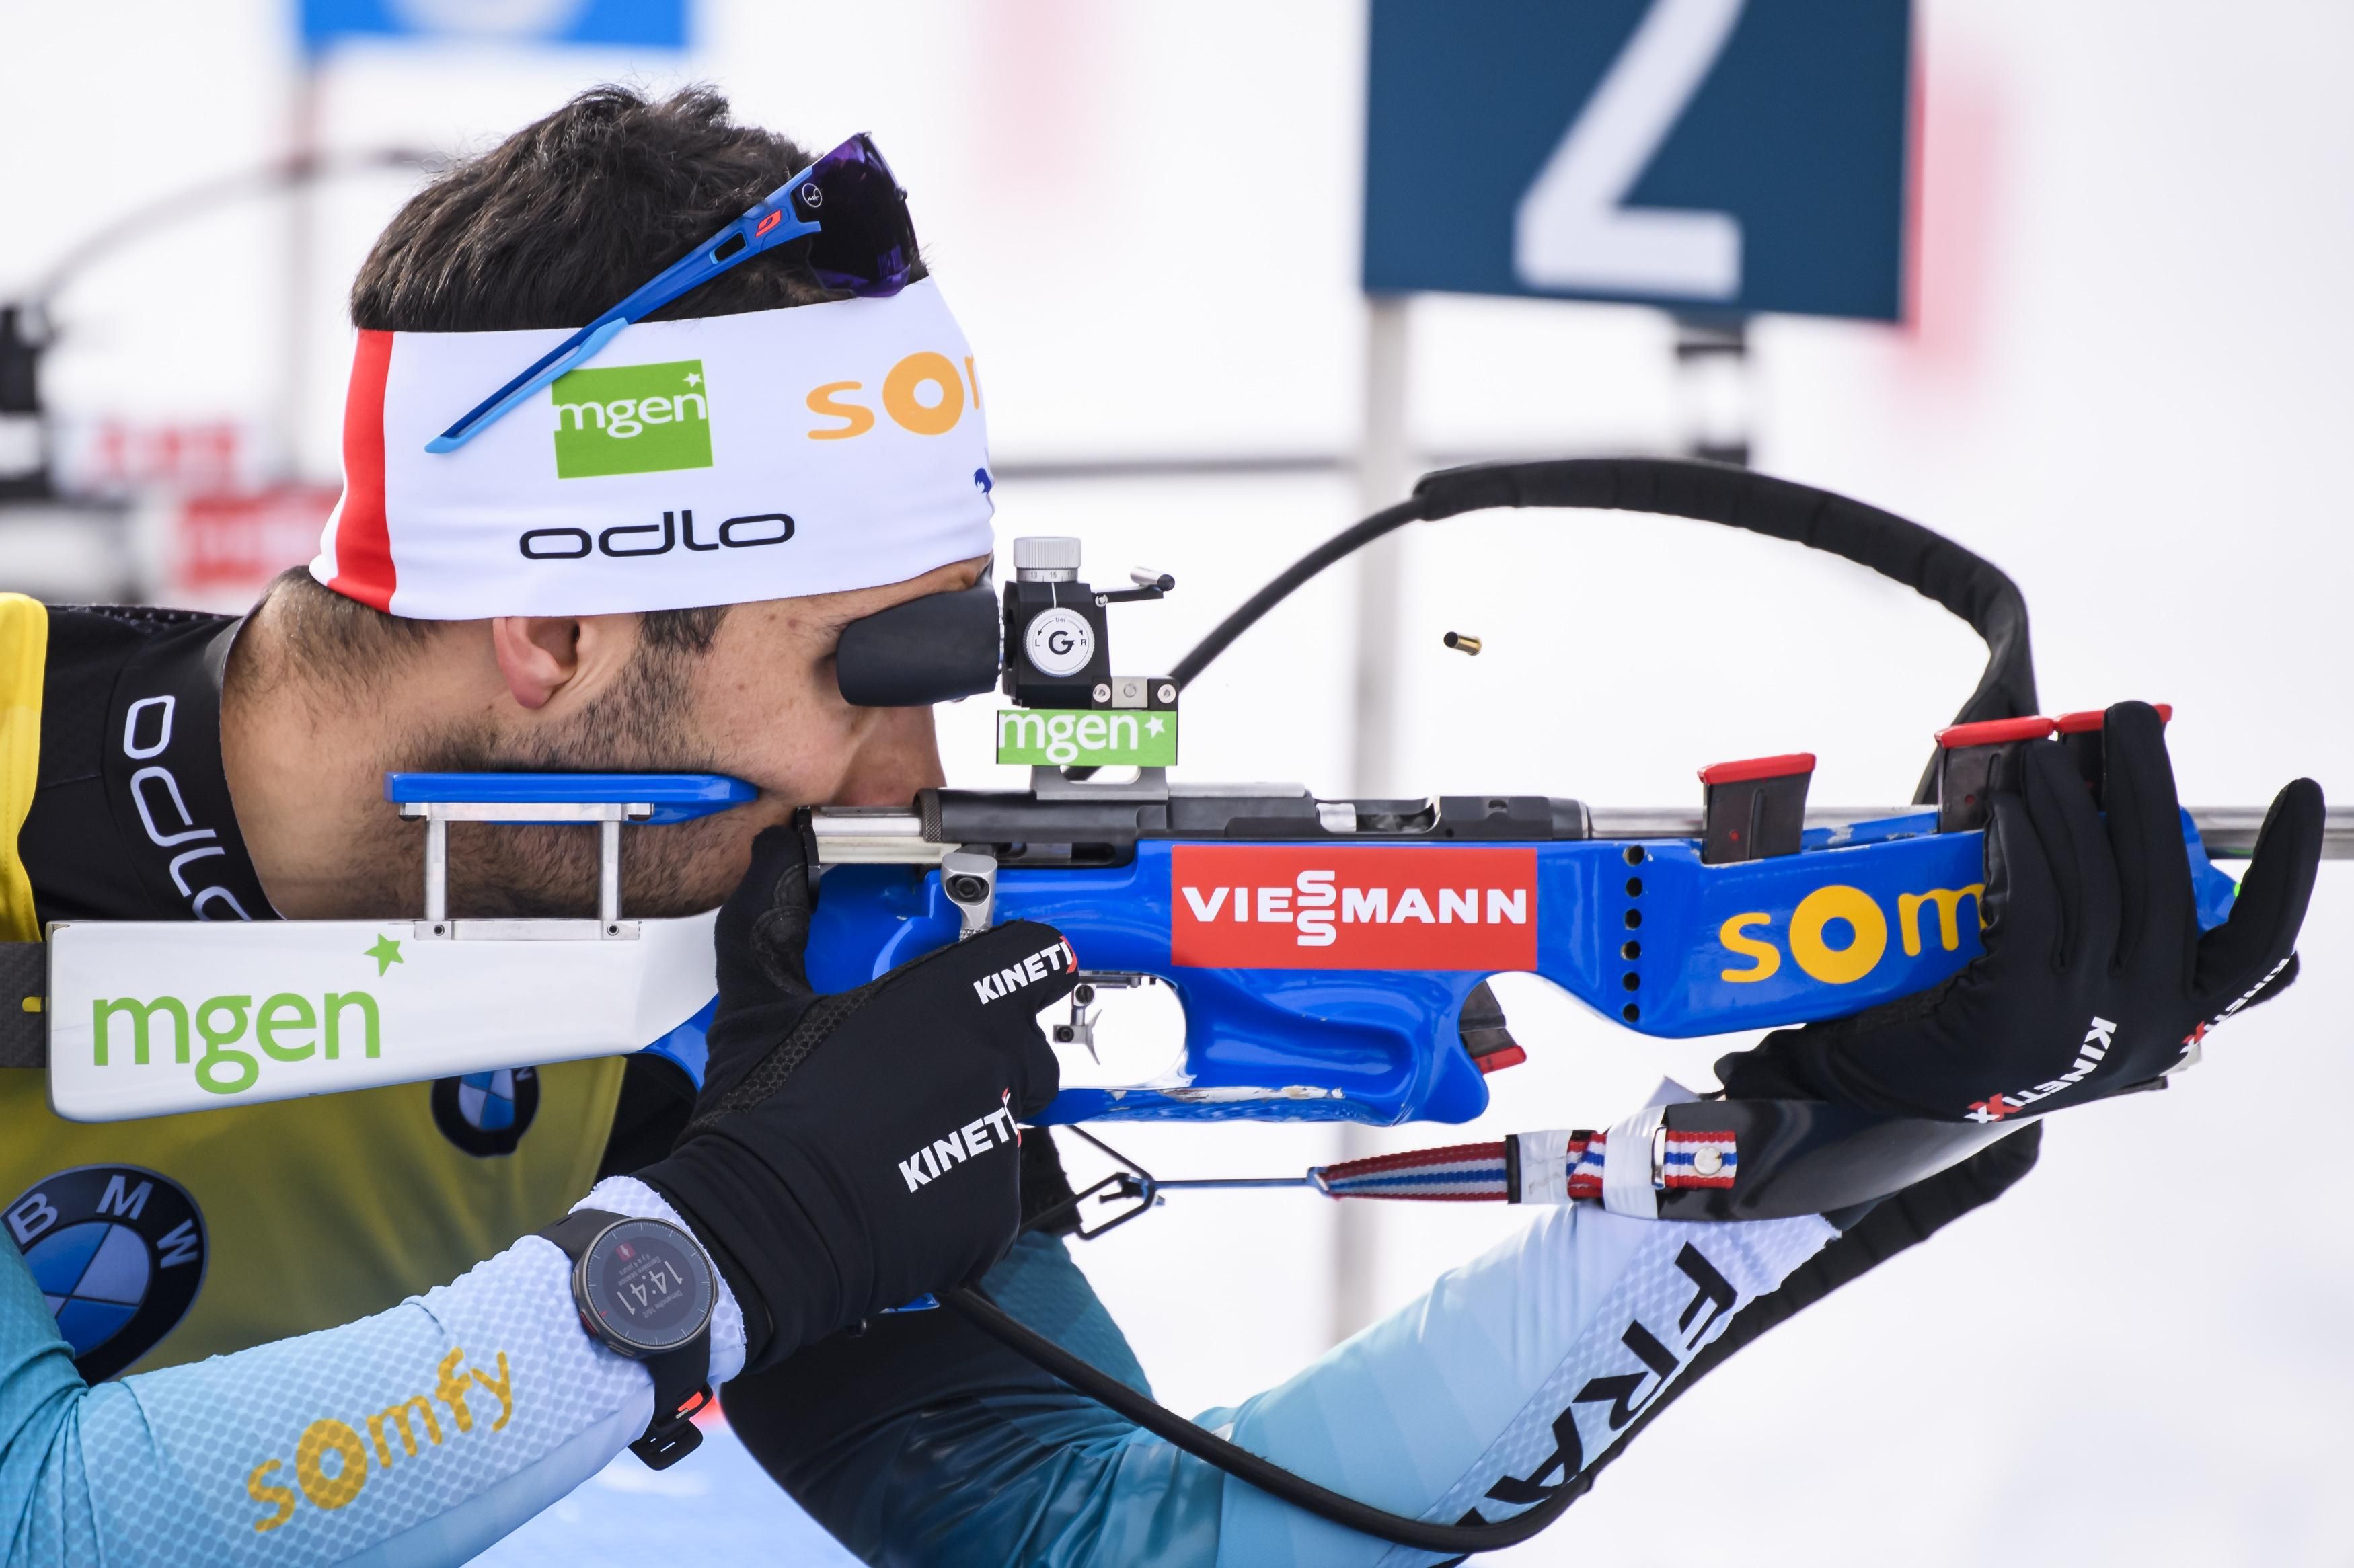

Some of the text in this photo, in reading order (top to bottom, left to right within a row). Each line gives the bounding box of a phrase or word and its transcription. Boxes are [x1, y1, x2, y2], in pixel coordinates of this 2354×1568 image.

[1513, 0, 1743, 301] 2
[555, 388, 706, 439] mgen
[519, 510, 795, 560] odlo
[999, 713, 1139, 765] mgen
[1181, 870, 1527, 947] VIESSMANN
[93, 990, 381, 1095] mgen
[617, 1261, 683, 1315] 14:41
[1426, 1241, 1738, 1568] FRA
